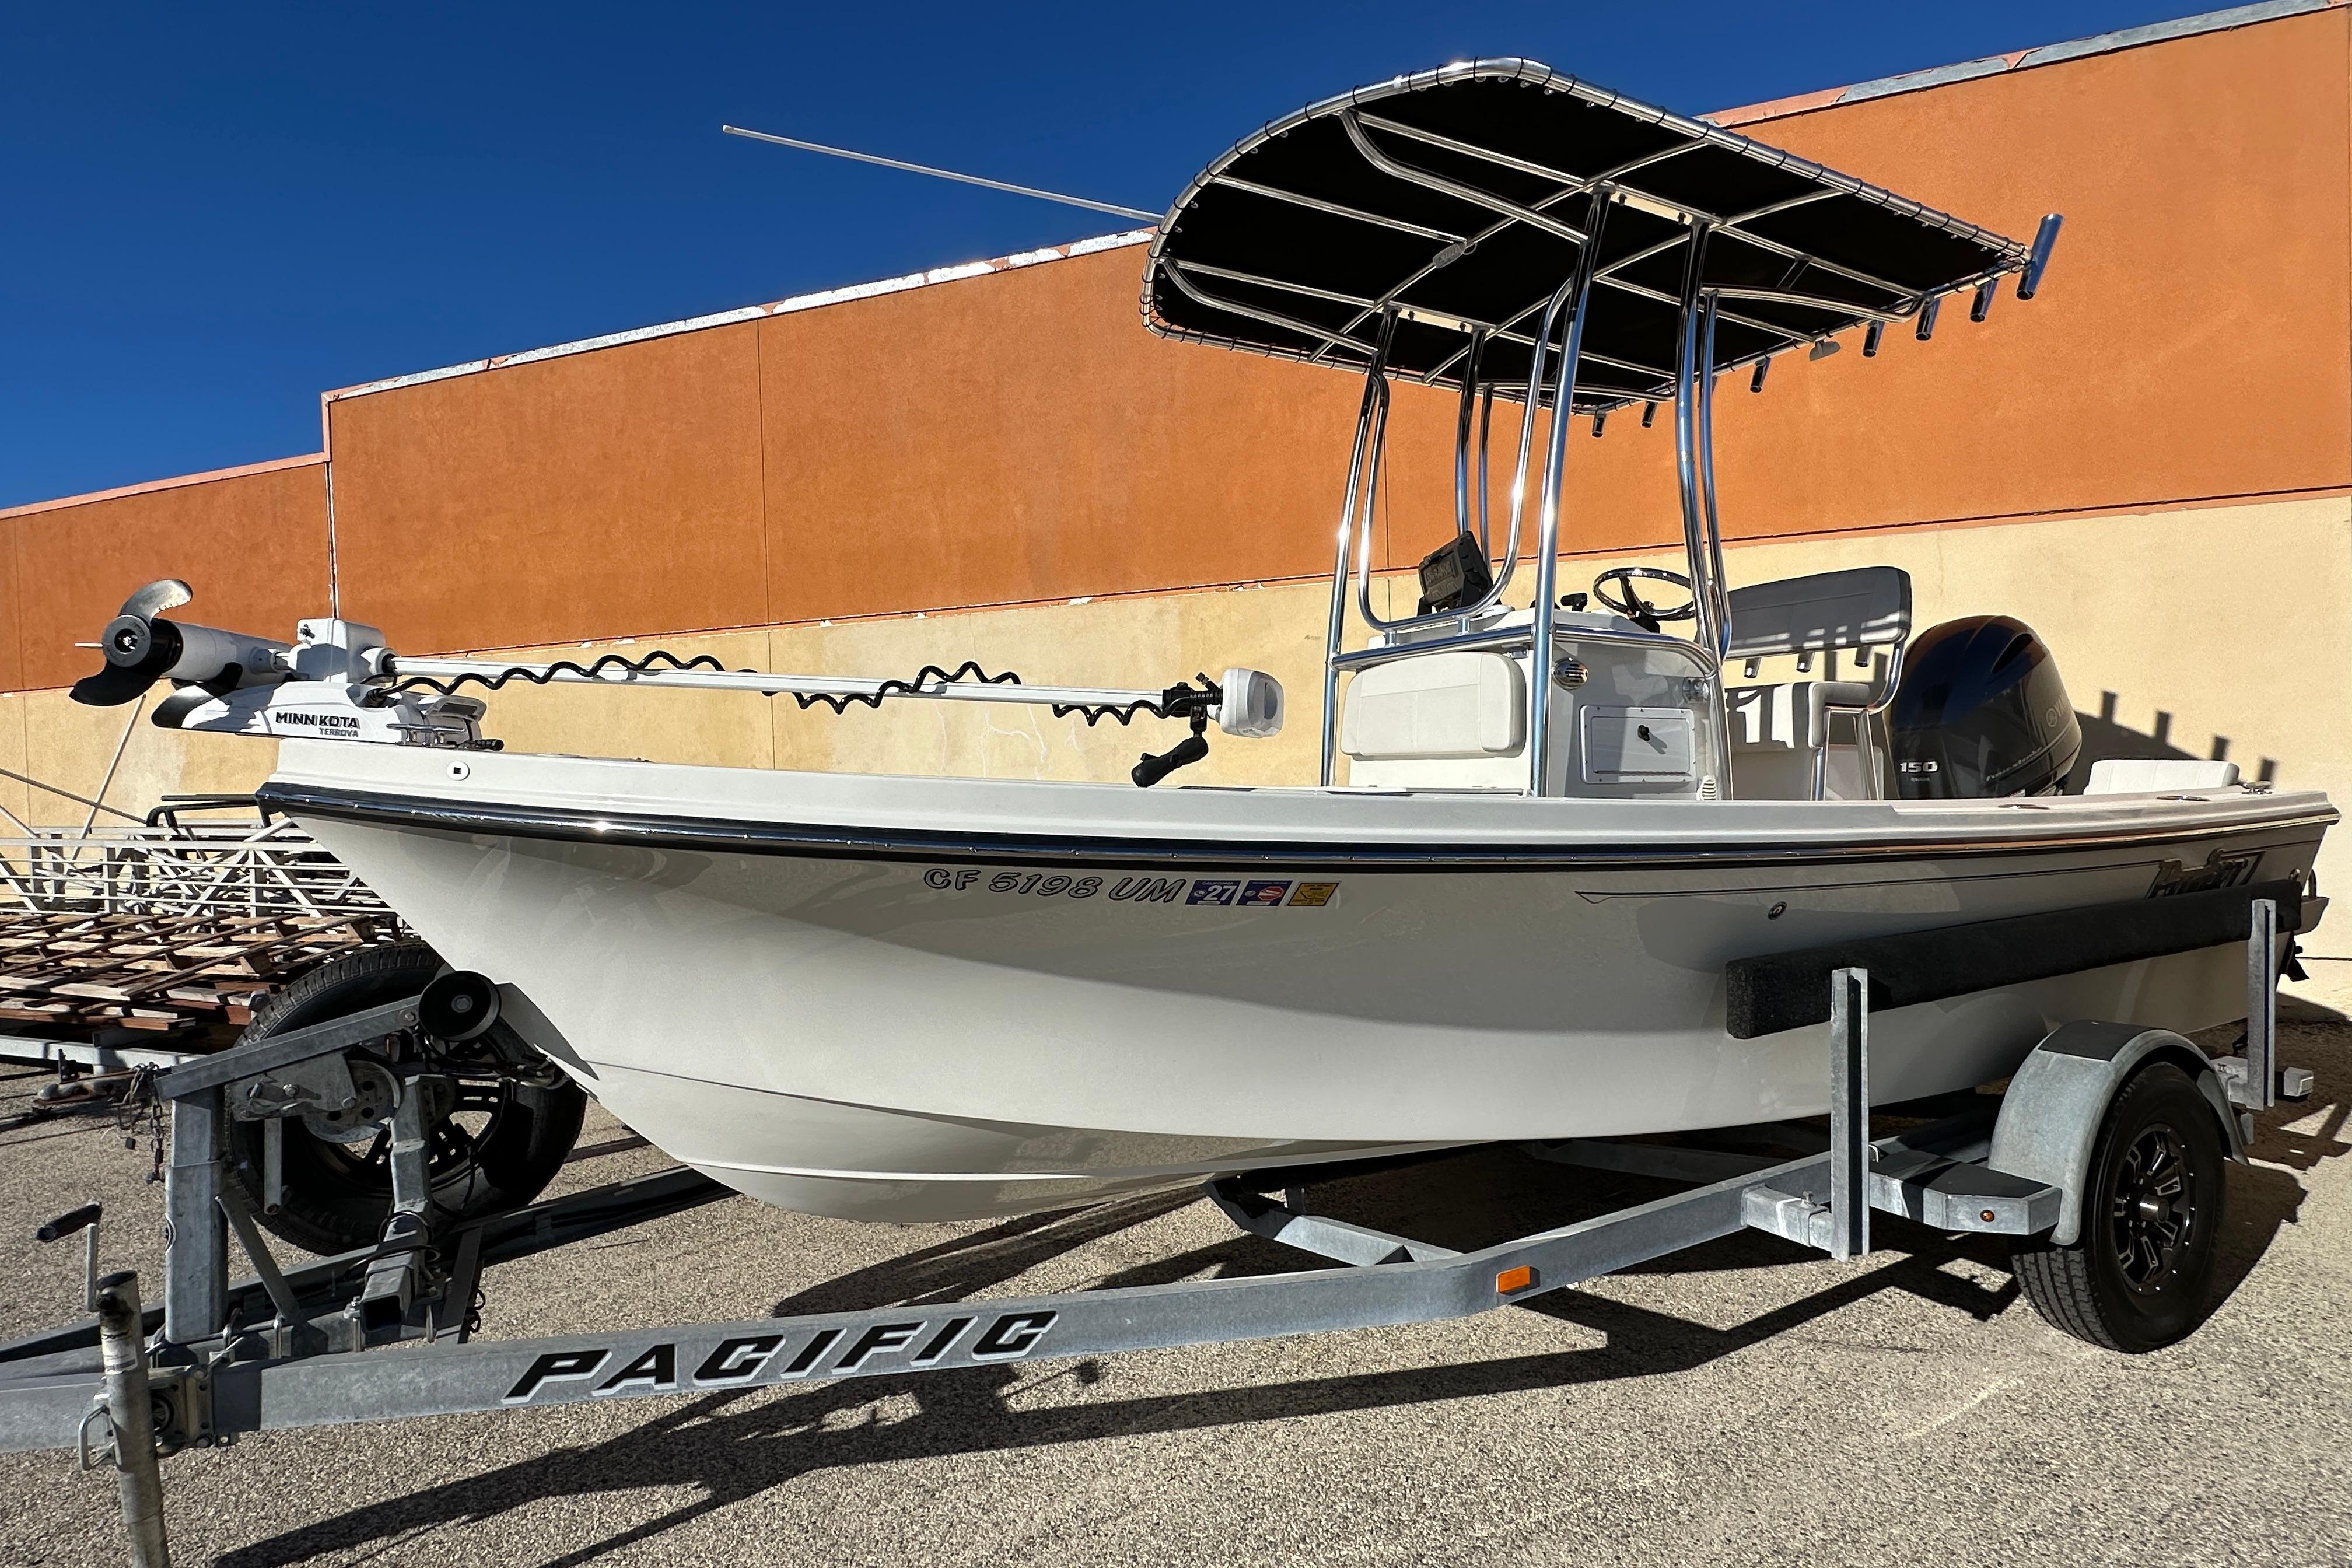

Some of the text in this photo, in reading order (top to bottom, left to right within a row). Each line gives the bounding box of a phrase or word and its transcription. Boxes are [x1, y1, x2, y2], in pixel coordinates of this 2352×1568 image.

[275, 712, 360, 729] MINN KOTA
[1899, 761, 1938, 772] 150
[923, 868, 1187, 903] CF 5198 UM
[1203, 885, 1237, 901] 27
[501, 1310, 1059, 1405] PACIFIC
